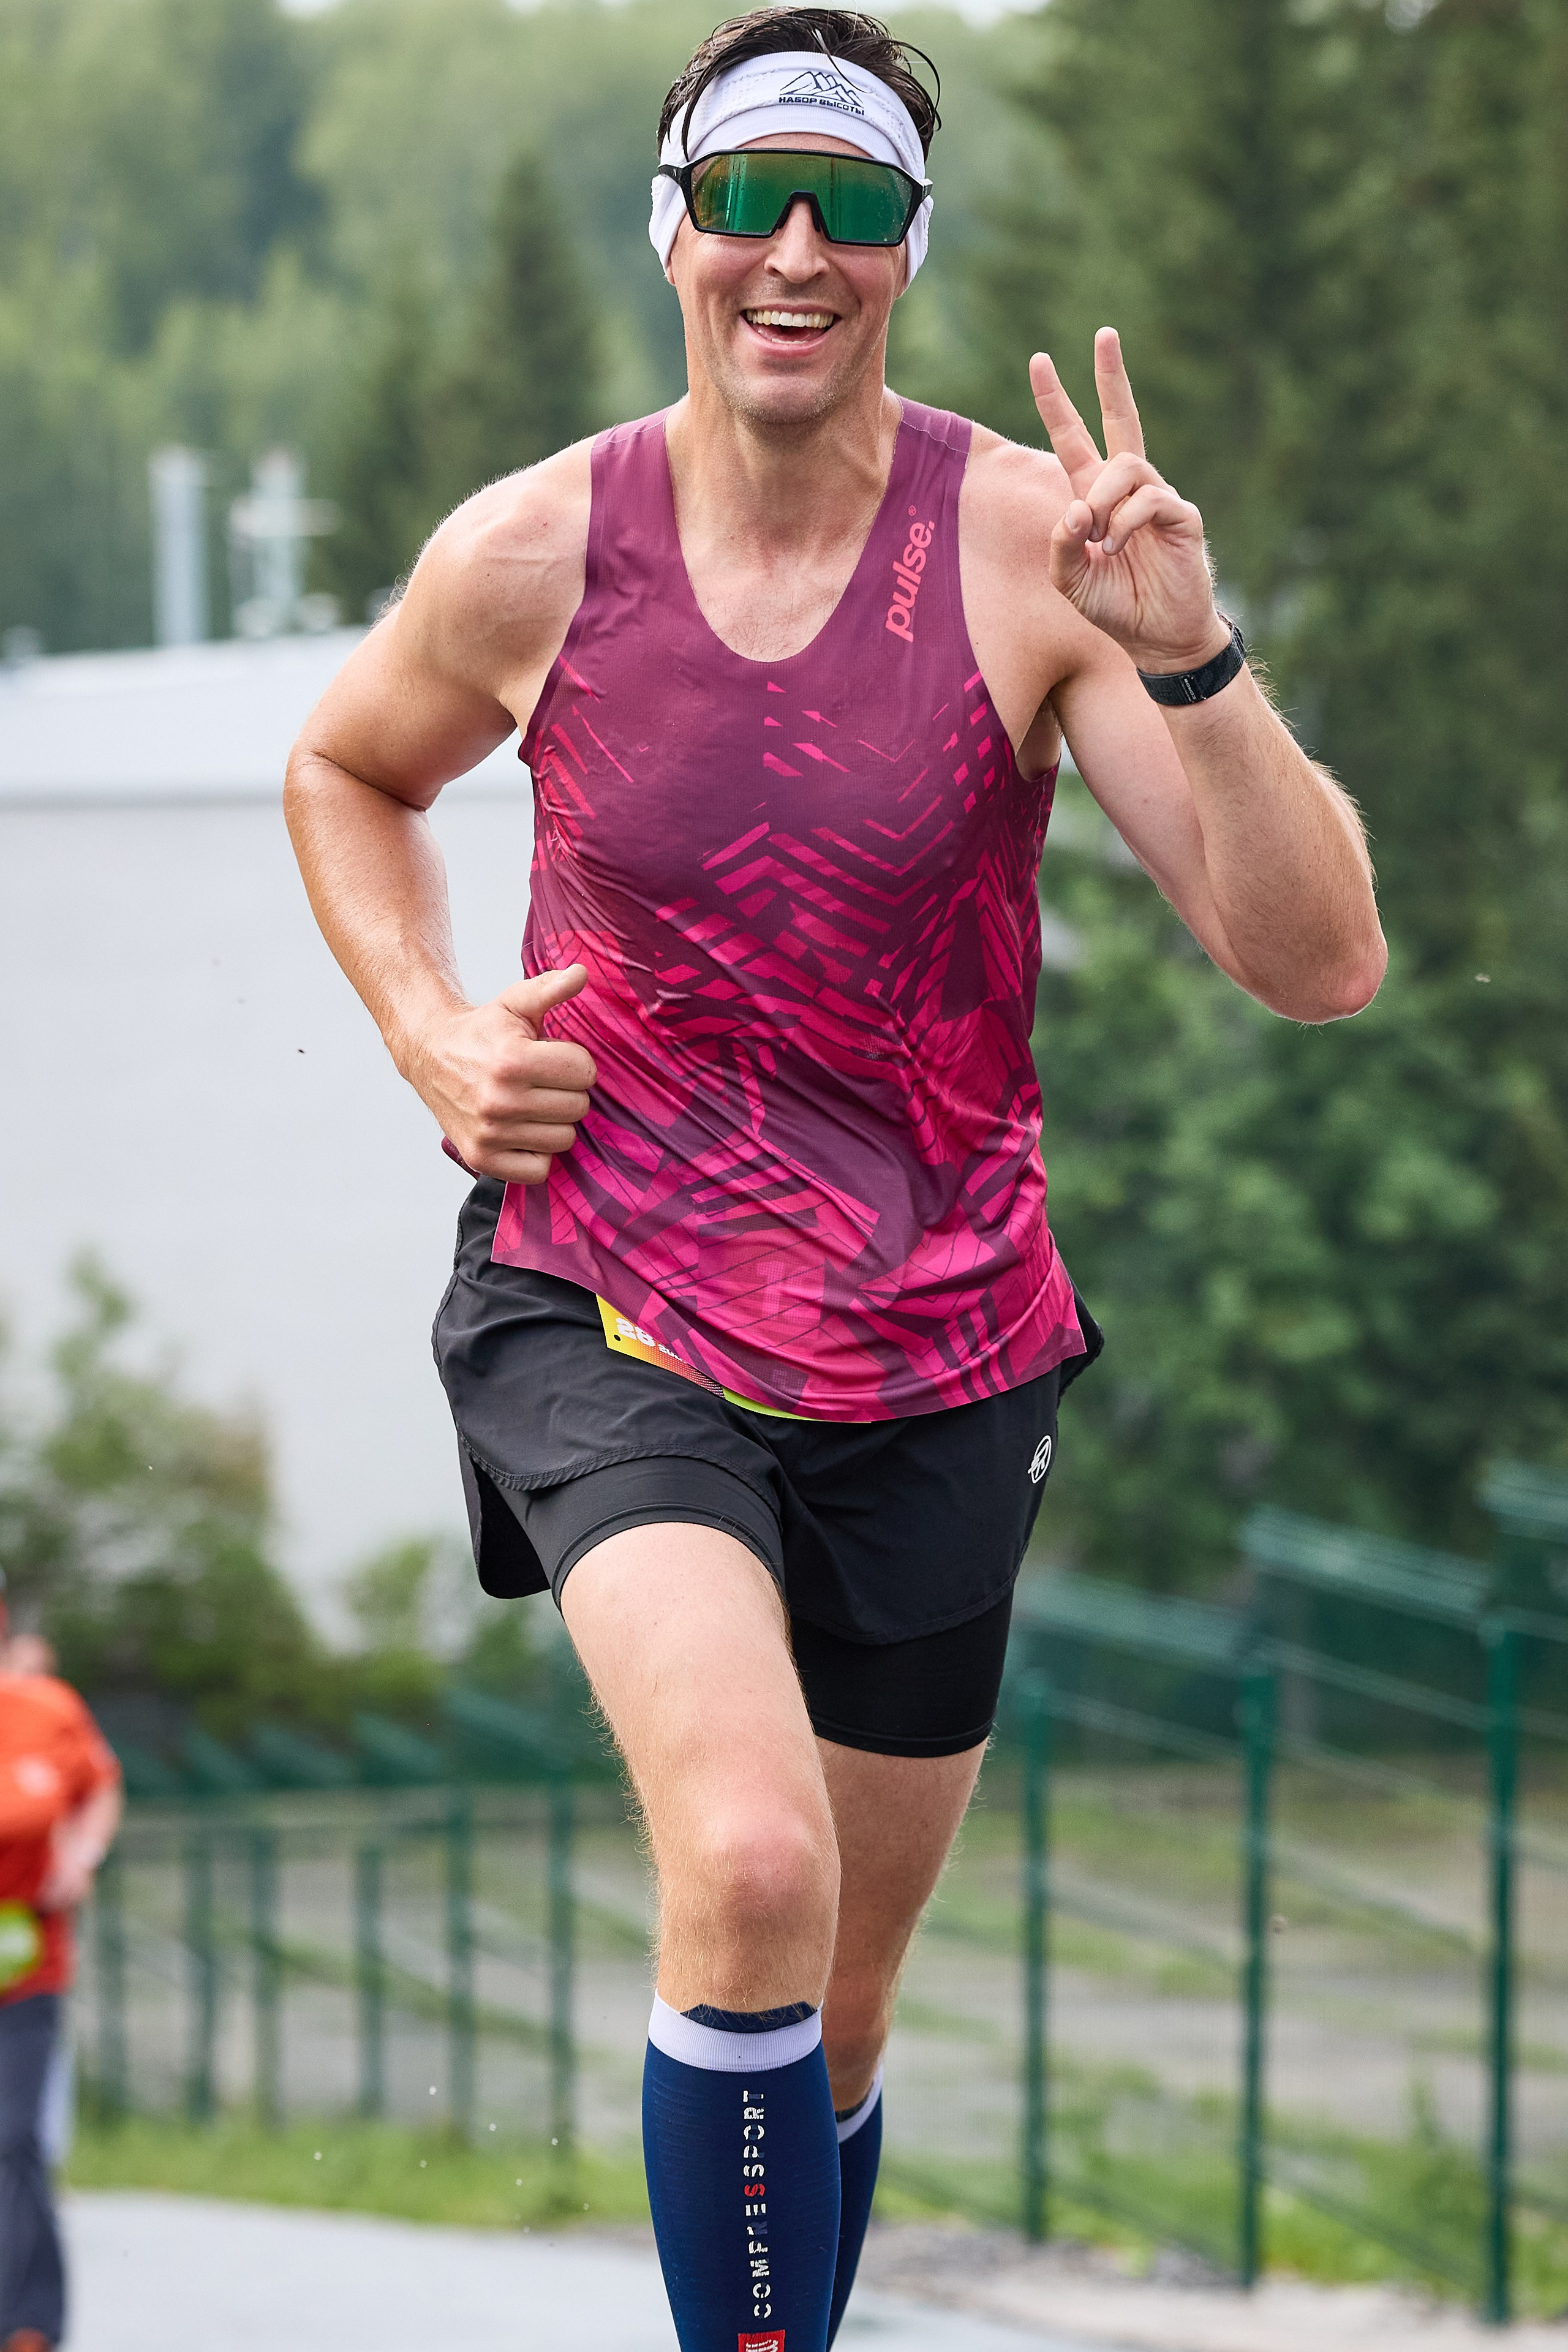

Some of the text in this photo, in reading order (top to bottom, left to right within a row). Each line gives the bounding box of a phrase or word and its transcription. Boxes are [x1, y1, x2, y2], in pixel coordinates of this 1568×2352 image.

[819, 99, 865, 116] ВЫСОТЫ
[885, 521, 935, 643] pulse.
[1184, 678, 1196, 699] COROS
[616, 1317, 655, 1347] 28
[743, 2090, 772, 2319] COMPRESSPORT
